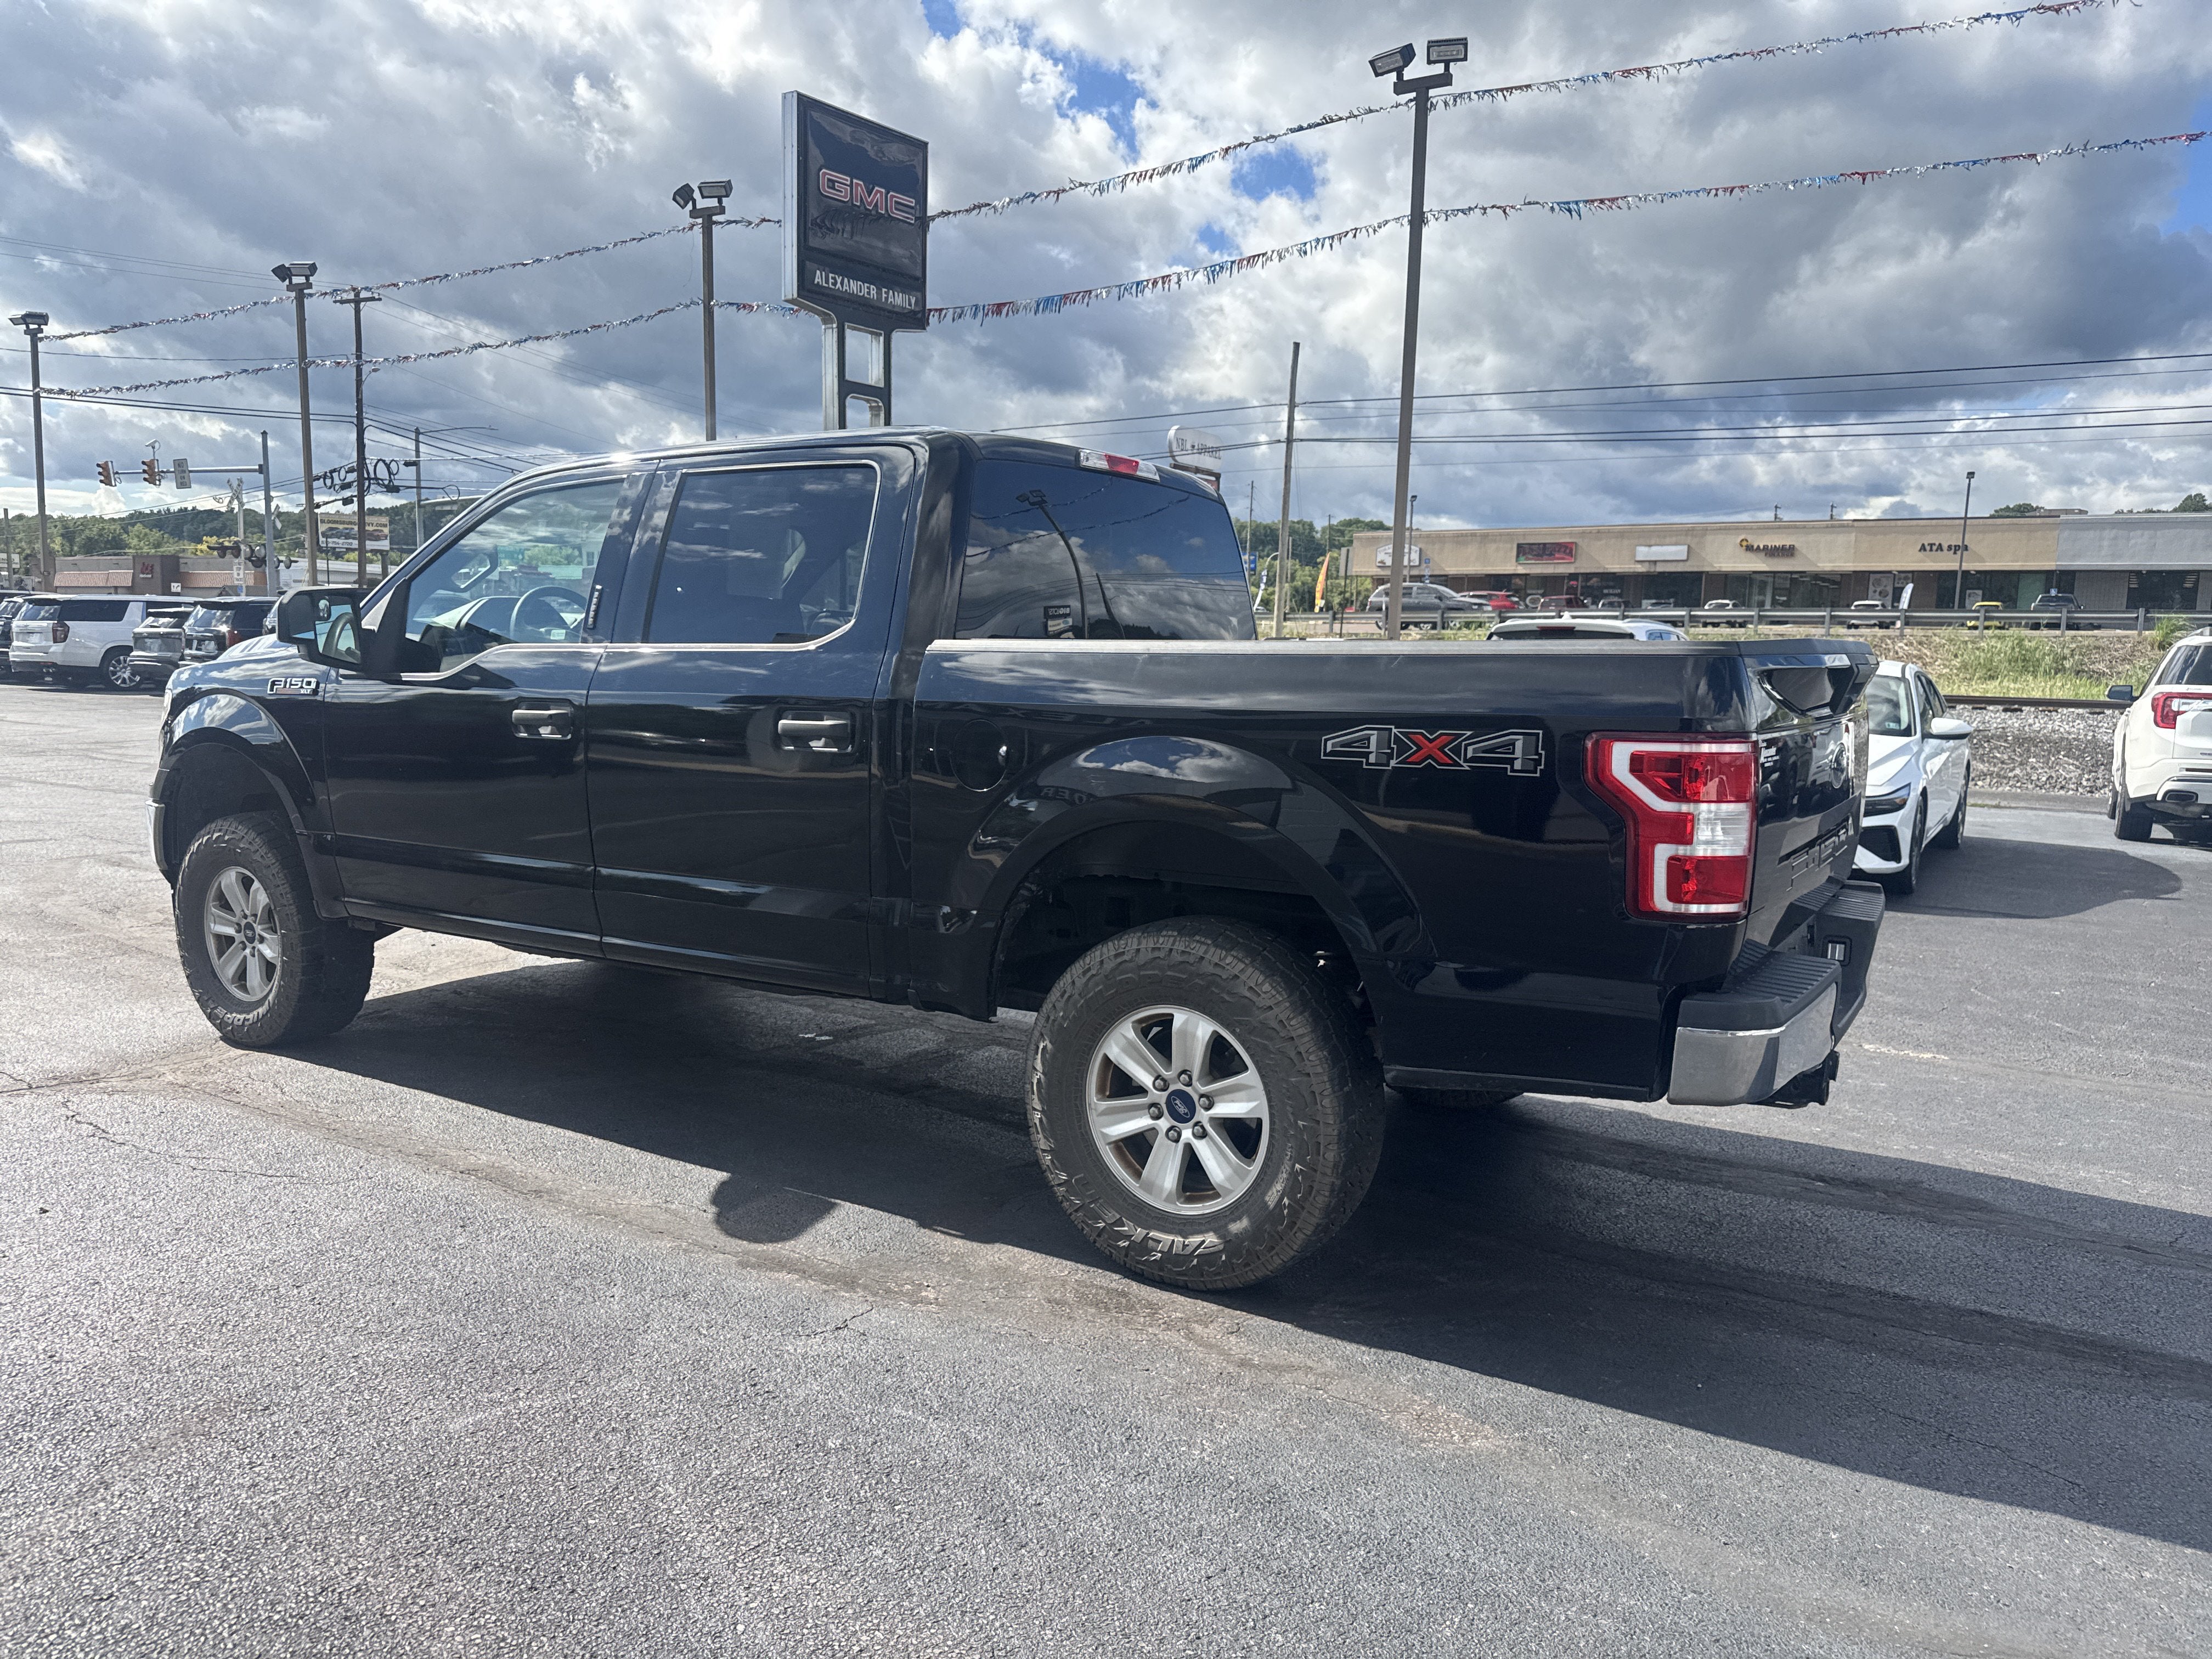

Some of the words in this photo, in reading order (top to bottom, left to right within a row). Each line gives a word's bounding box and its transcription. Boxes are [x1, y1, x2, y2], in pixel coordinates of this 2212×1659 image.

[819, 168, 916, 223] GMC
[814, 269, 877, 300] ALEXANDER
[882, 288, 916, 309] FAMILY
[1918, 543, 1944, 552] ATA
[1946, 544, 1968, 555] spa
[1173, 1099, 1188, 1114] Ford
[1071, 1173, 1225, 1256] FALKEN
